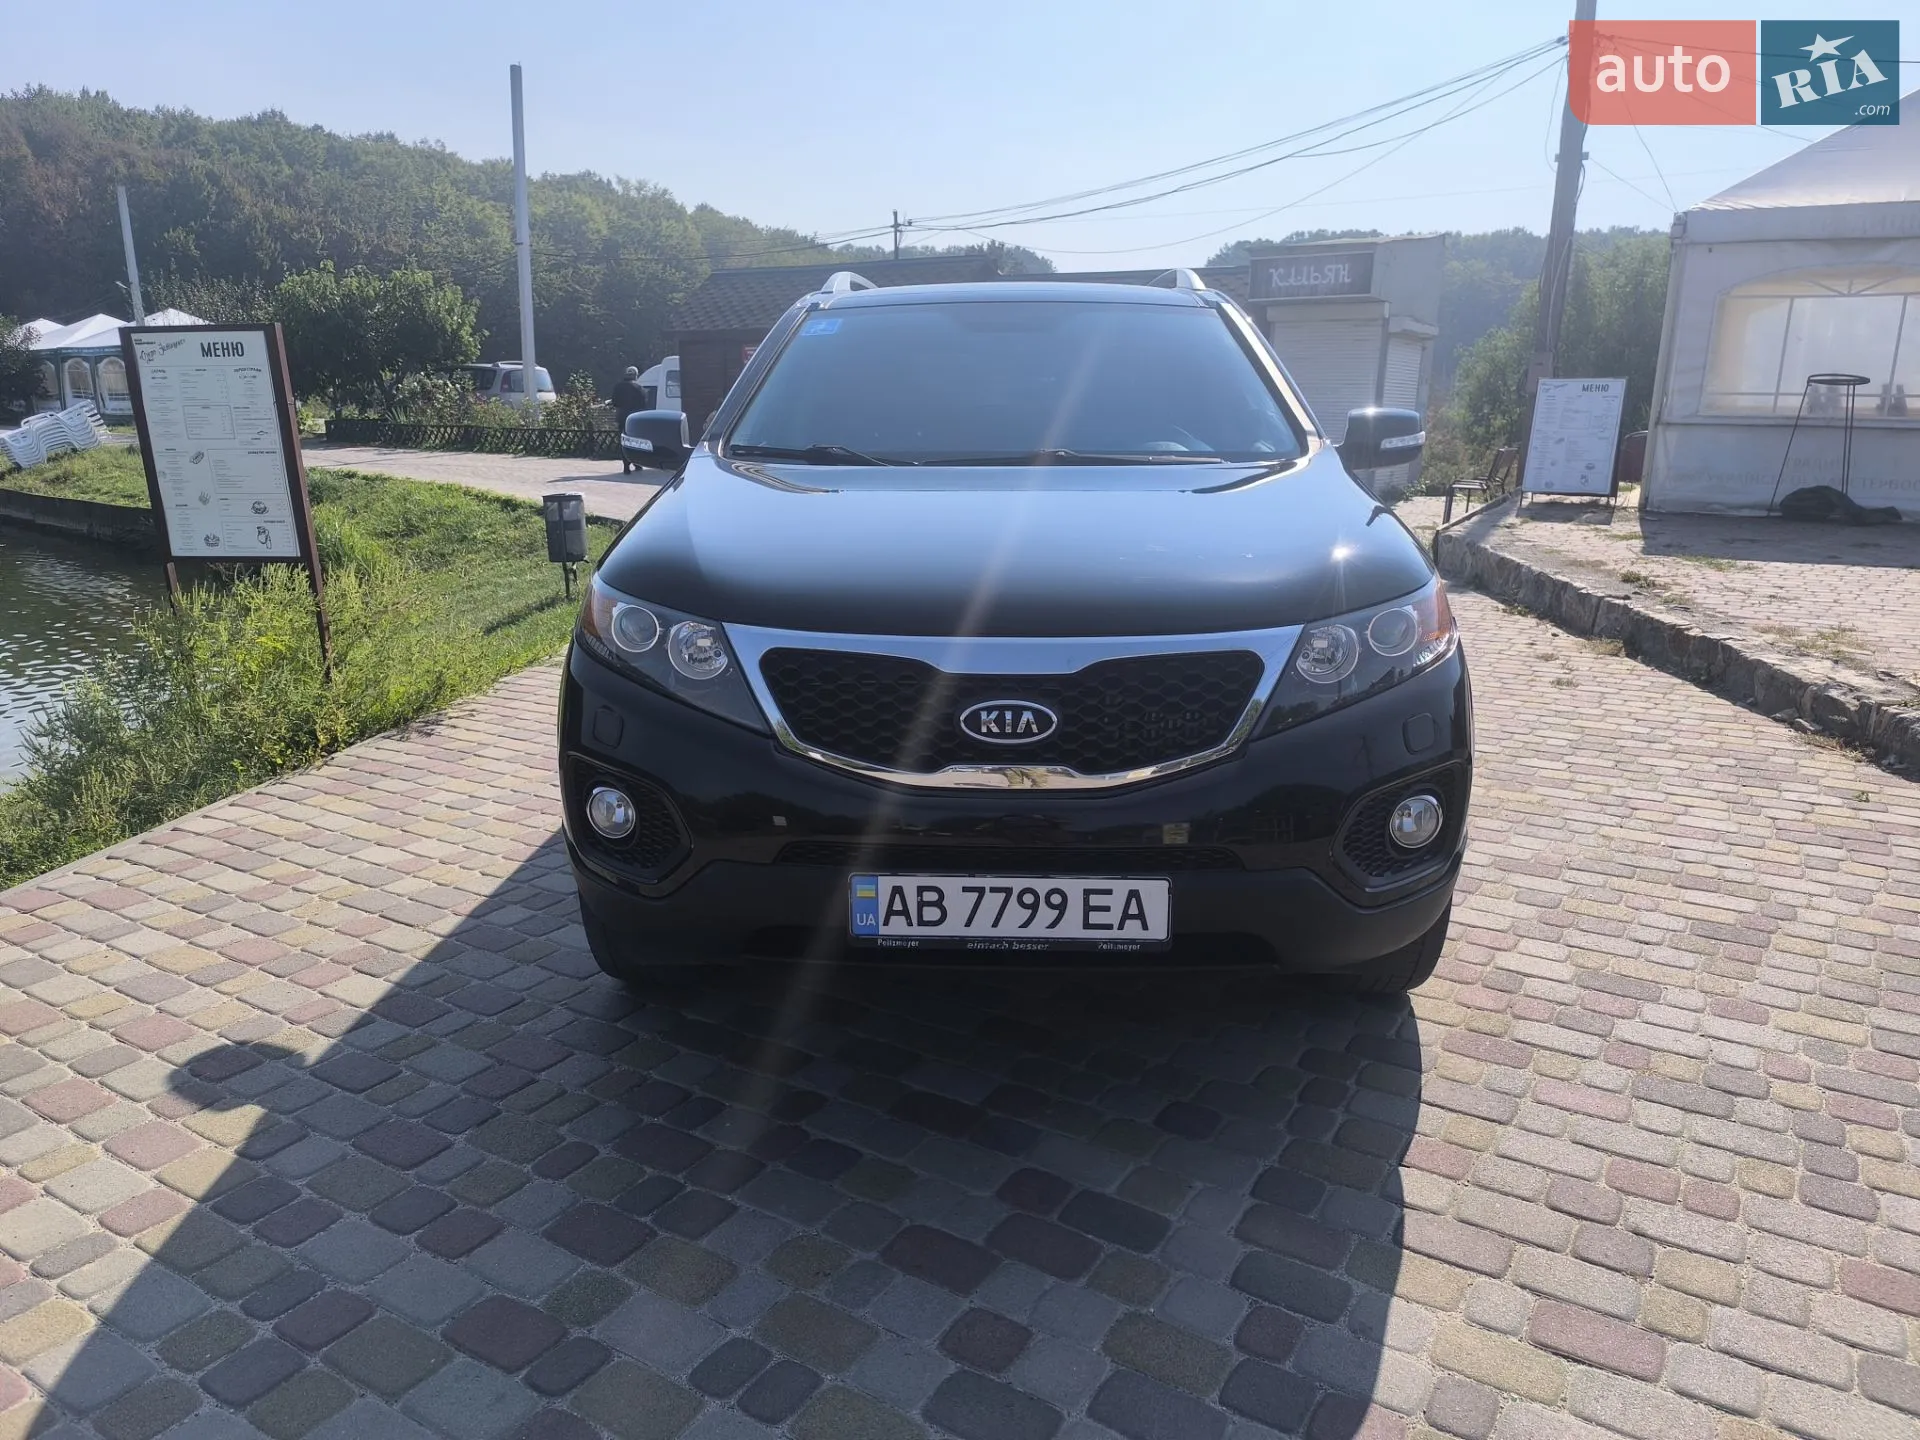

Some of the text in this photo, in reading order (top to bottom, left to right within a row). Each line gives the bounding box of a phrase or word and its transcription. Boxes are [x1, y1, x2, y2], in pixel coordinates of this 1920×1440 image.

[200, 341, 245, 358] МЕНЮ
[1581, 383, 1610, 393] МЕНЮ
[980, 711, 1038, 733] KIA
[882, 885, 1149, 931] AB 7799 EA
[856, 913, 876, 926] UA
[1011, 941, 1050, 950] besser
